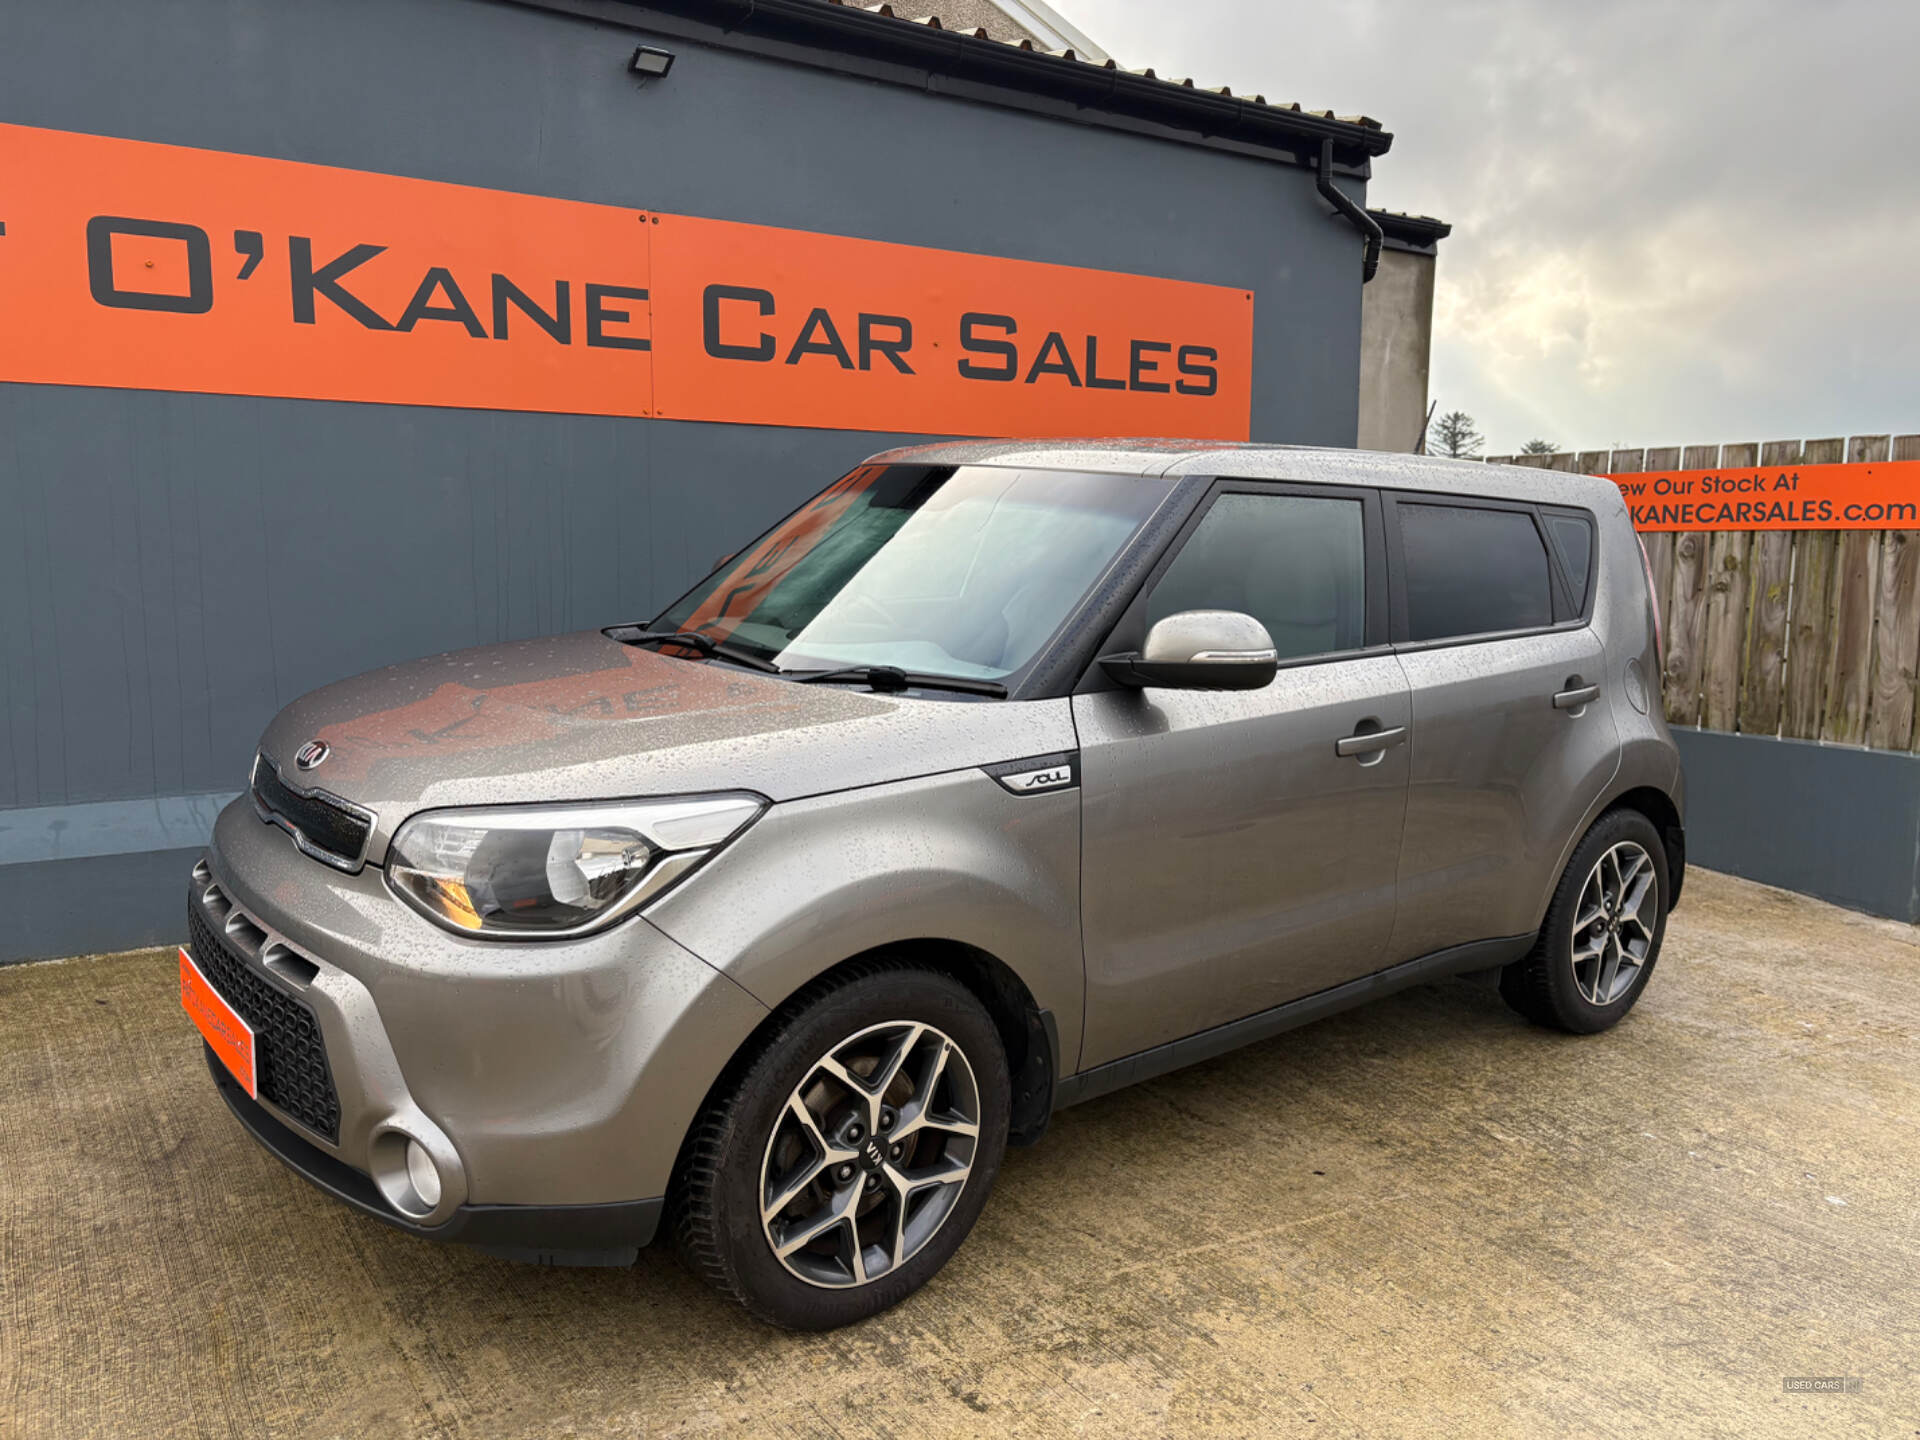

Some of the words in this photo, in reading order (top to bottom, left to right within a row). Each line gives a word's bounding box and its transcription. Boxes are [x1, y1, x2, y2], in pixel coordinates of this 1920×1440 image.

[958, 312, 1217, 396] SALES
[1654, 479, 1694, 496] Our
[1701, 475, 1766, 495] Stock
[1773, 473, 1799, 492] At
